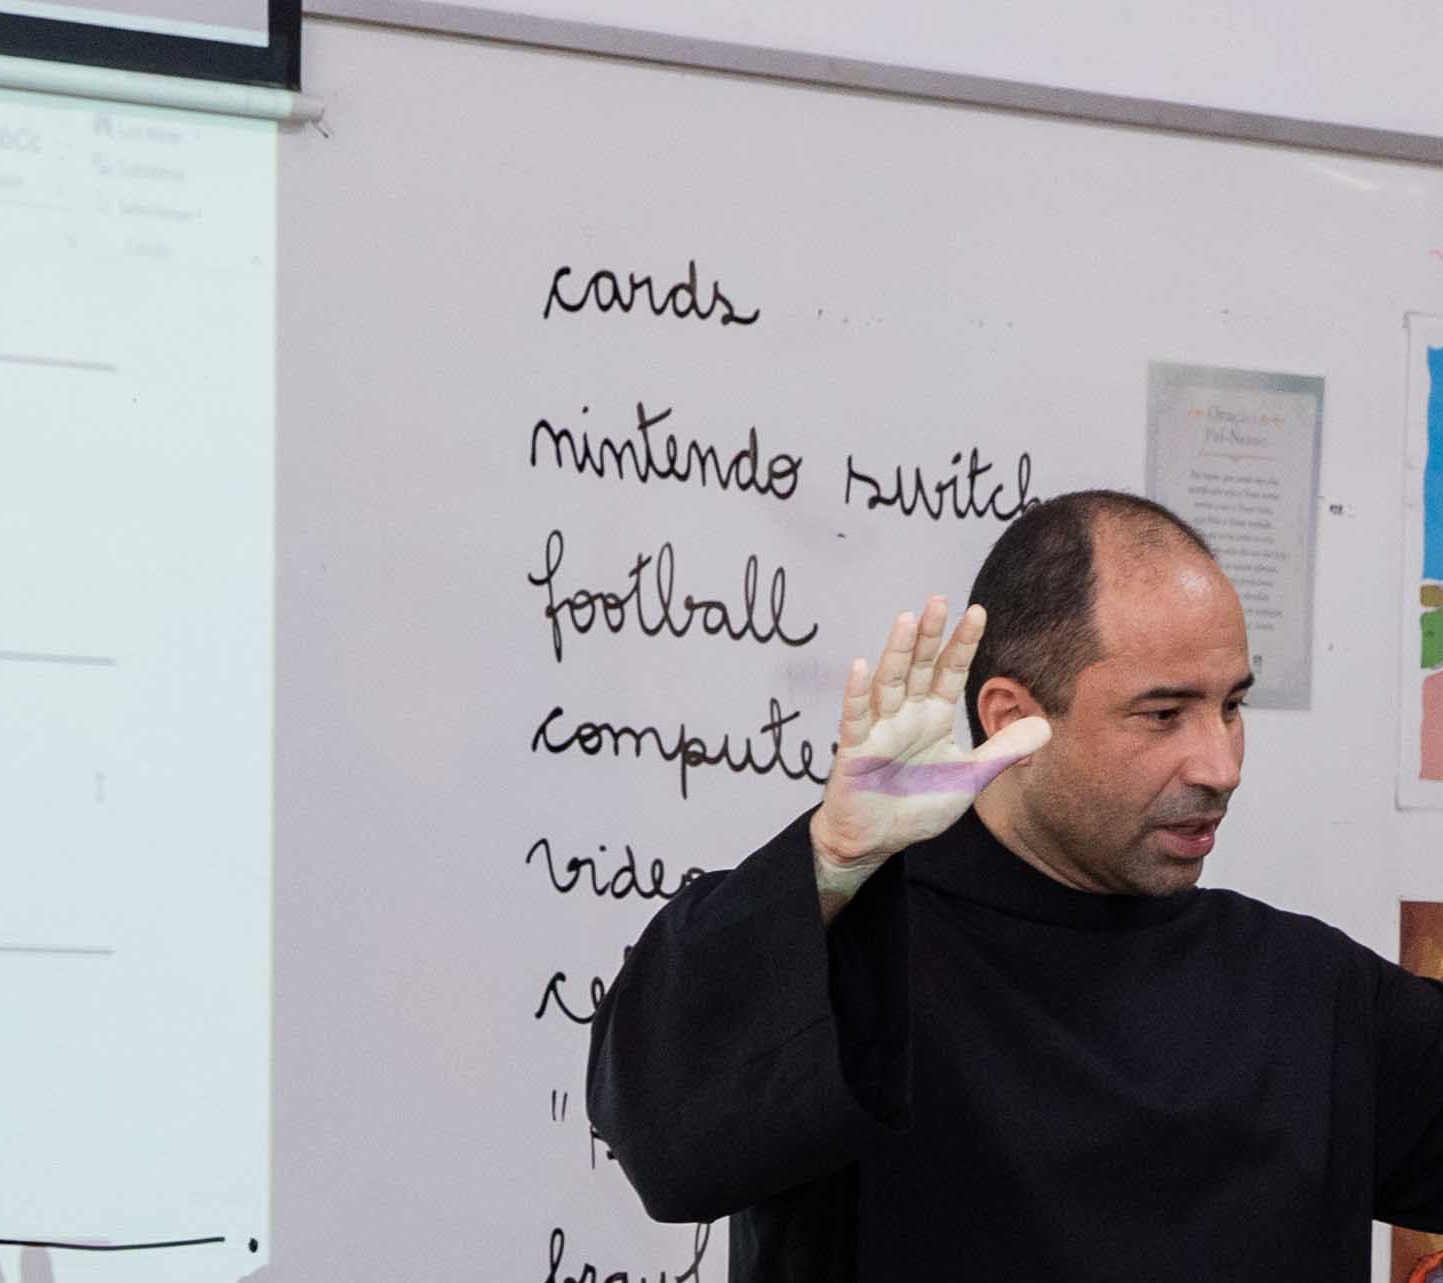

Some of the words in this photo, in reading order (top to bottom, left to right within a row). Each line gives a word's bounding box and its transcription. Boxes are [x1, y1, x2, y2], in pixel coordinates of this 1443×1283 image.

[544, 260, 759, 325] cards
[530, 402, 803, 499] nintendo
[845, 447, 1043, 520] switch
[528, 530, 819, 662] football
[530, 697, 840, 798] compute
